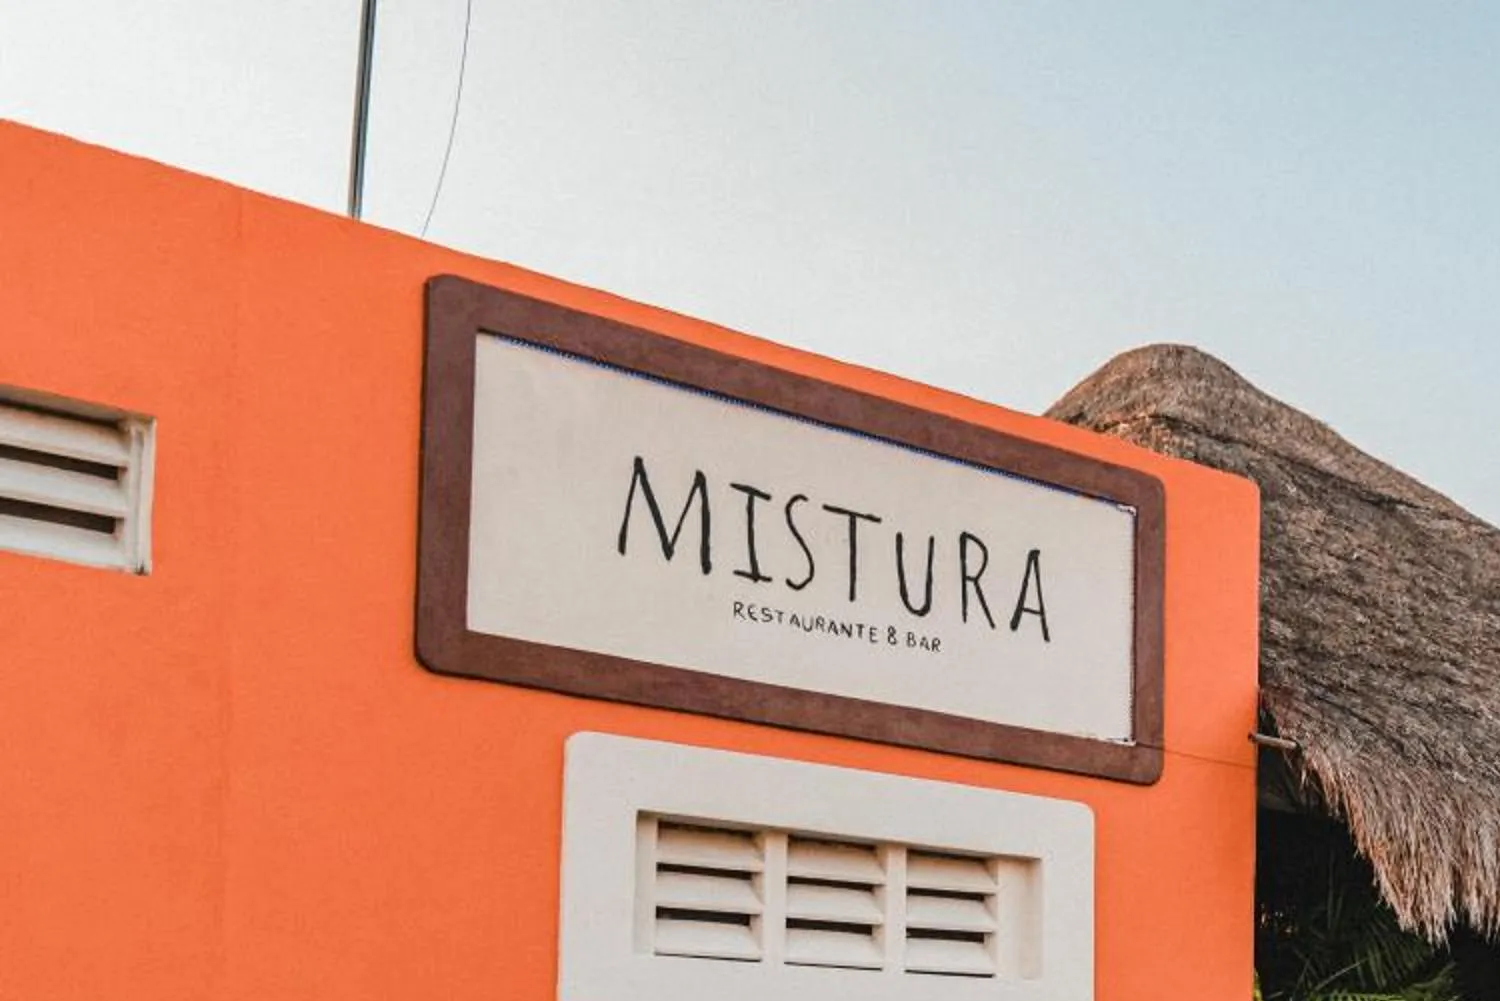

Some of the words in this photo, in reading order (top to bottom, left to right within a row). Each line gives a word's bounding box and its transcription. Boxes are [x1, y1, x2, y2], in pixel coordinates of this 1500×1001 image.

[617, 455, 1051, 644] MISTURA
[732, 600, 879, 644] RESTAURANTE
[887, 625, 898, 647] &
[905, 629, 943, 654] BAR
